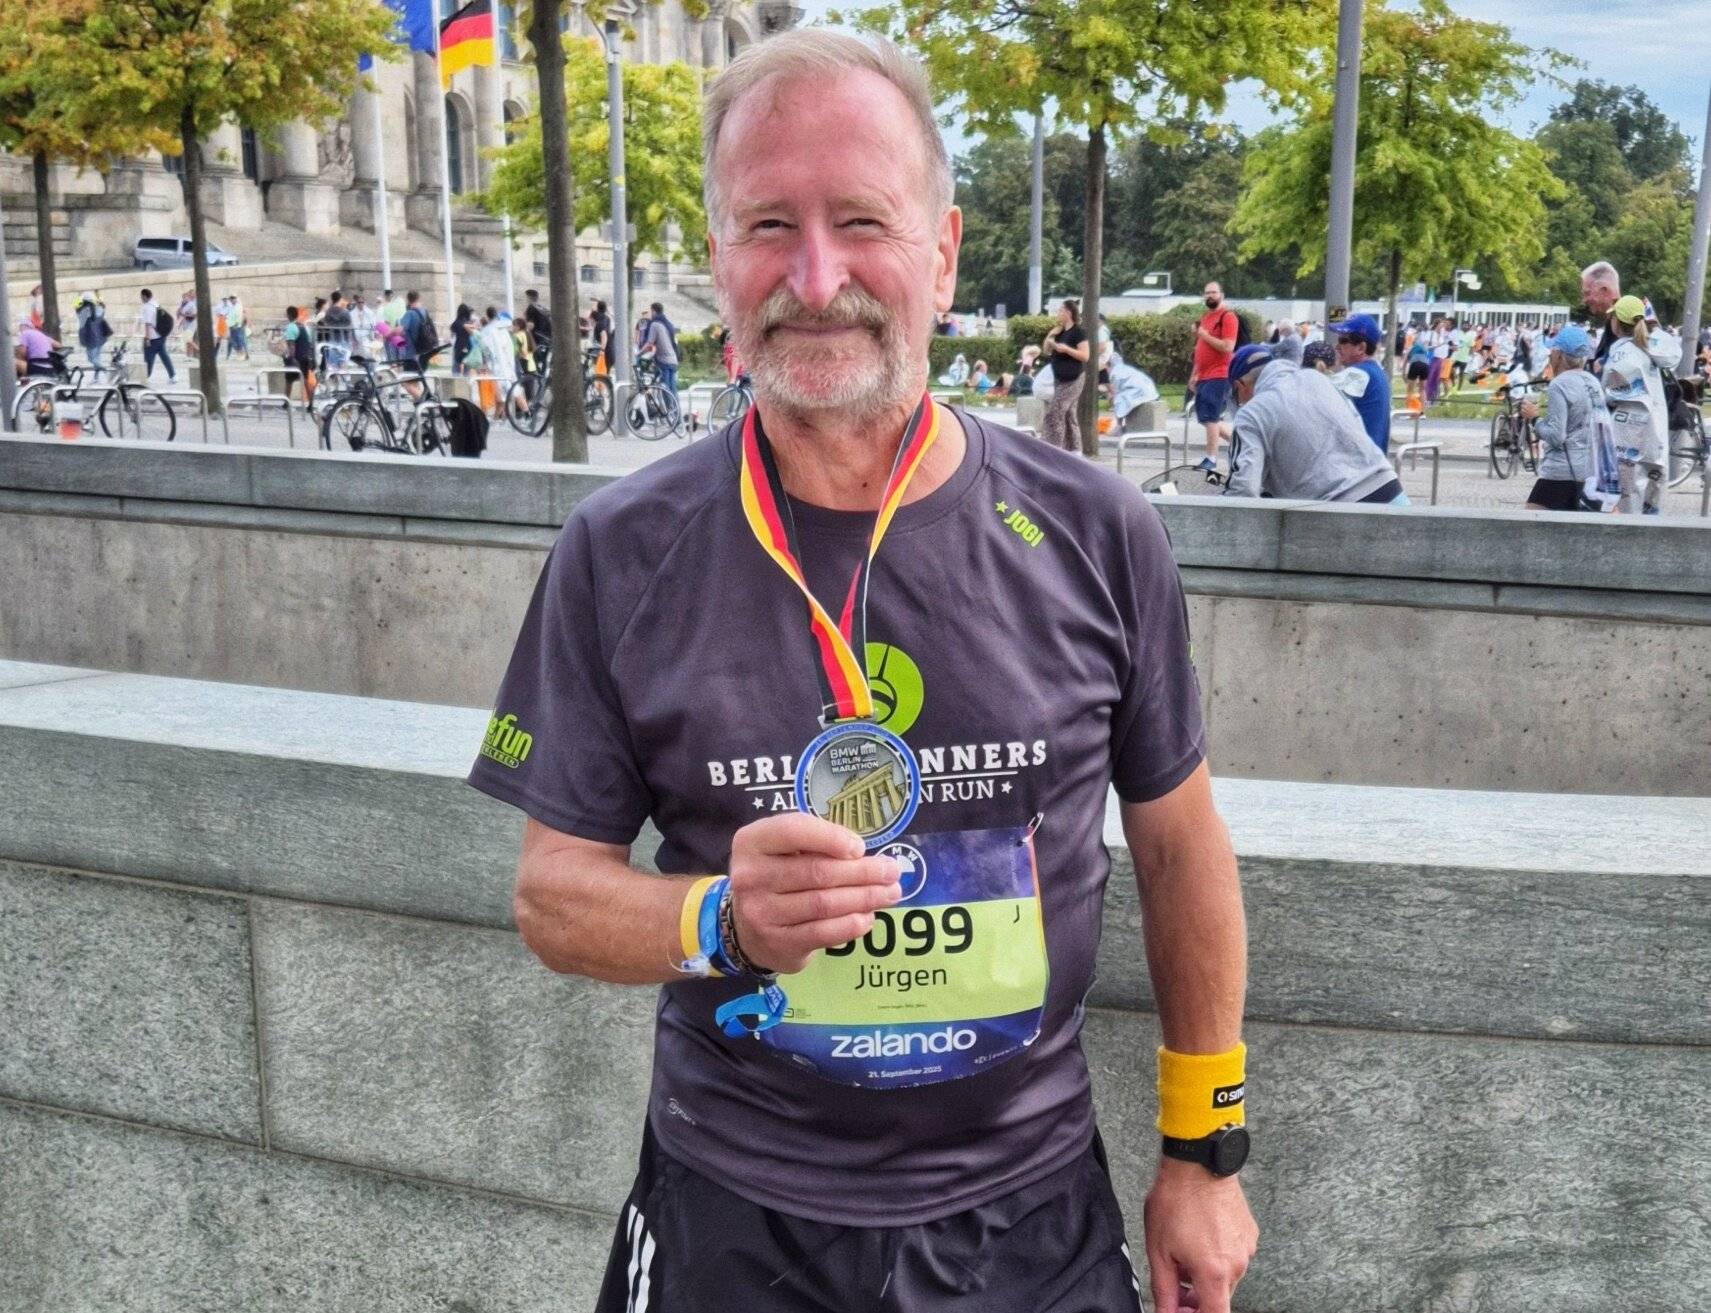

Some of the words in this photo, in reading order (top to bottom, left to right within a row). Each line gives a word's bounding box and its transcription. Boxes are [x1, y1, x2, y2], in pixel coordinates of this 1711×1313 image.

[1003, 510, 1045, 547] JOGI
[830, 746, 860, 759] BMW
[831, 757, 861, 767] BERLIN
[707, 755, 798, 787] BERL
[832, 761, 880, 773] MARATHON
[941, 780, 995, 803] RUN
[1013, 904, 1020, 924] J
[854, 964, 948, 993] Jürgen
[830, 1026, 977, 1058] zalando
[881, 1068, 922, 1079] September
